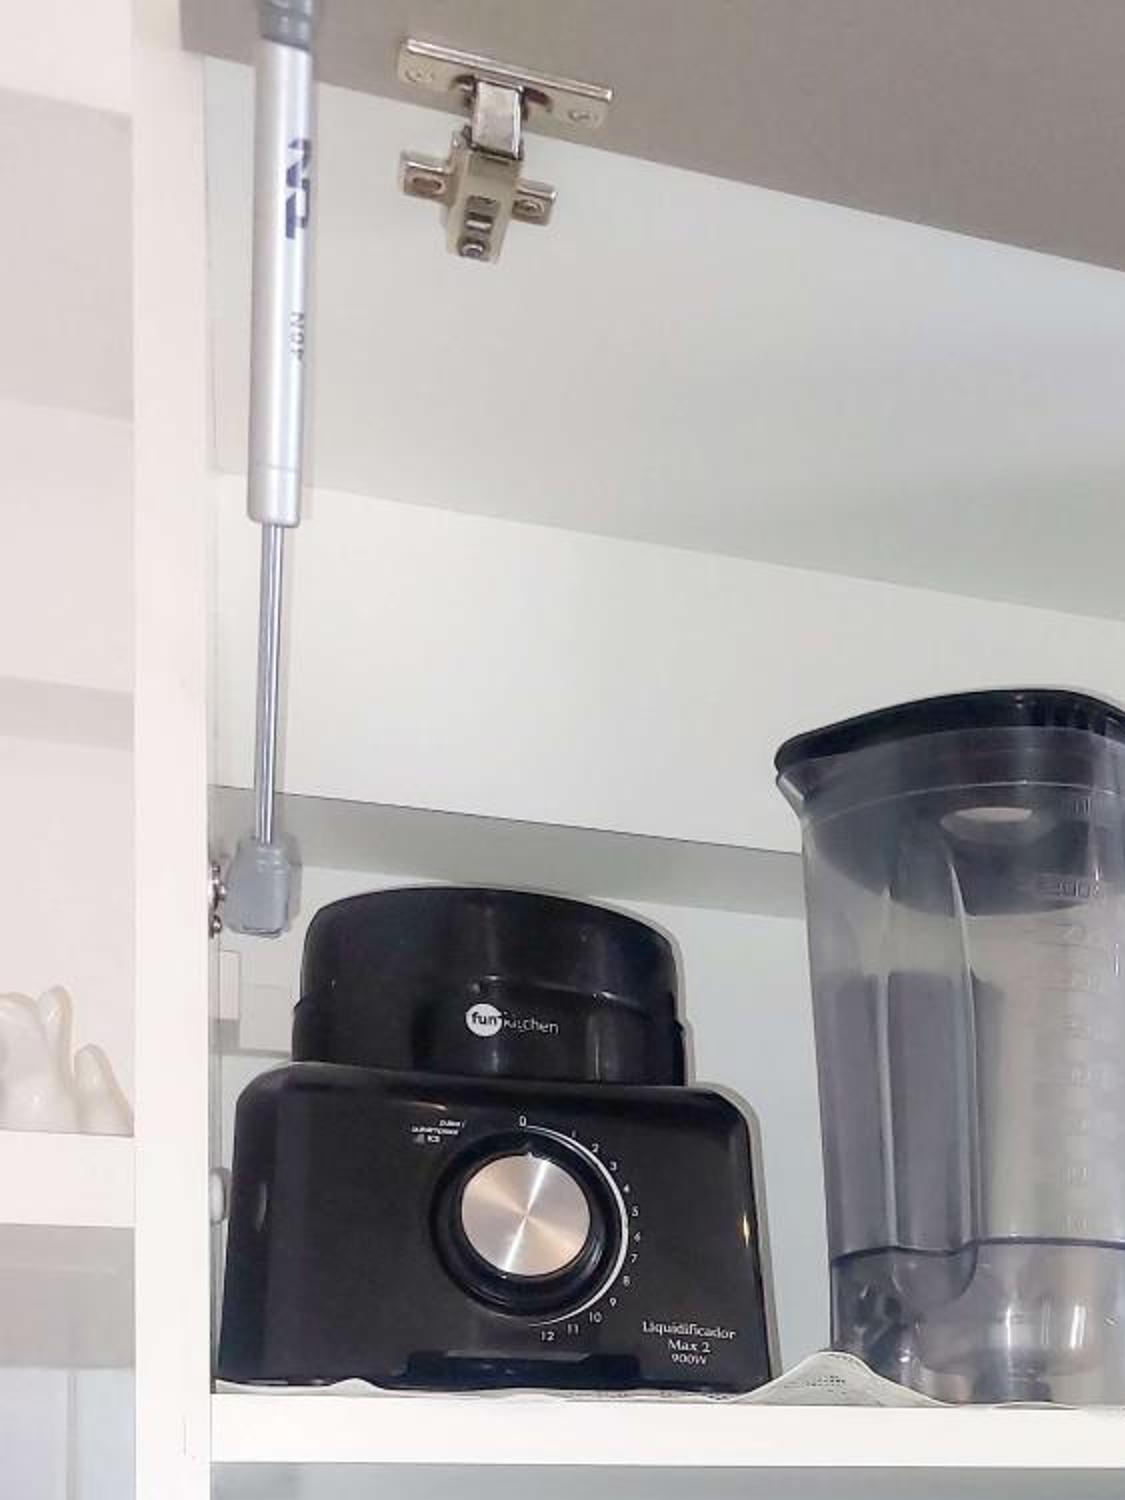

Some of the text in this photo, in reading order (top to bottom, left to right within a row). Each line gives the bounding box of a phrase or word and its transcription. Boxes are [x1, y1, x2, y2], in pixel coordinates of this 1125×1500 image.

[472, 1011, 501, 1025] fun
[518, 1115, 528, 1127] 0
[609, 1161, 617, 1171] 3
[631, 1206, 639, 1217] 5
[630, 1254, 638, 1263] 7
[609, 1298, 617, 1308] 9
[588, 1311, 602, 1323] 10
[567, 1323, 579, 1335] 11
[641, 1320, 737, 1339] Liquidificador
[540, 1330, 555, 1341] 12
[668, 1339, 711, 1353] Max 2
[671, 1353, 707, 1365] 900W
